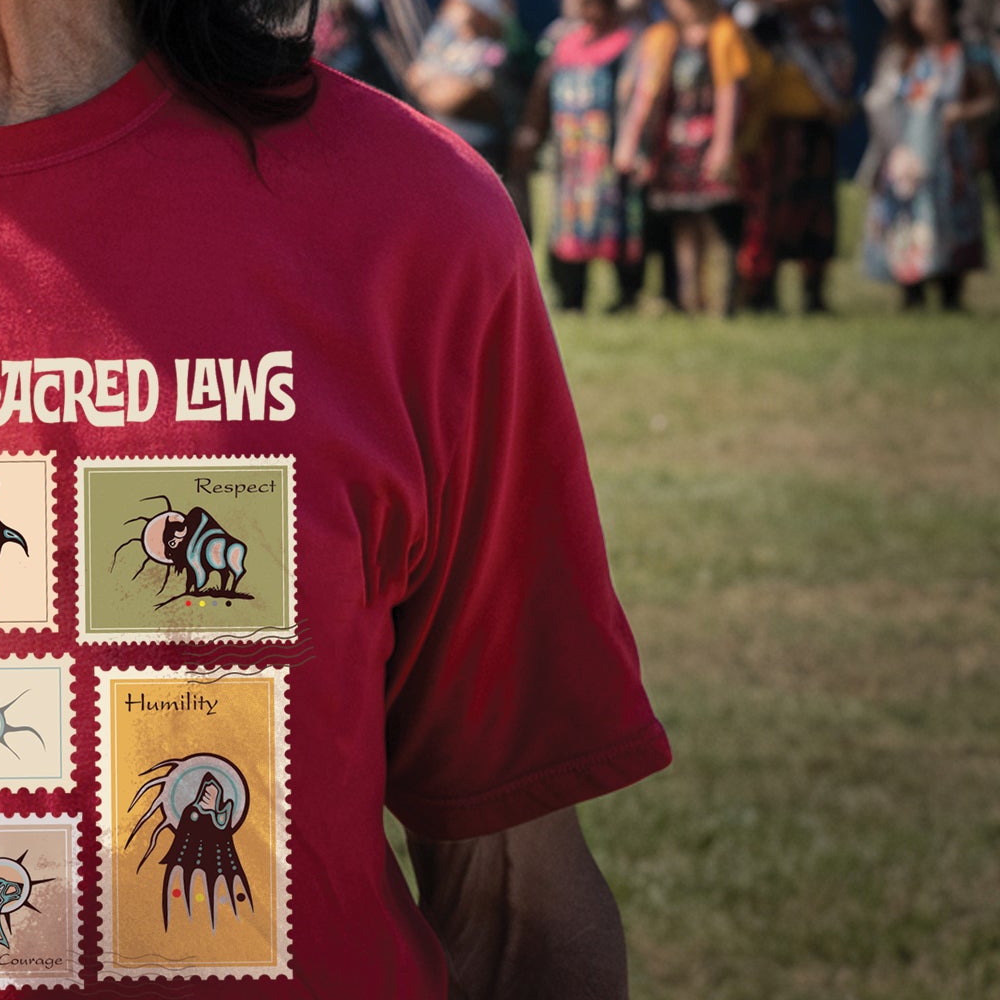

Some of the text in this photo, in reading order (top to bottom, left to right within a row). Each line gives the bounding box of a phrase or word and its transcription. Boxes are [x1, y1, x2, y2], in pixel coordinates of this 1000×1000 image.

[174, 350, 296, 422] LAWS
[194, 477, 277, 498] Respect
[125, 691, 219, 717] Humility
